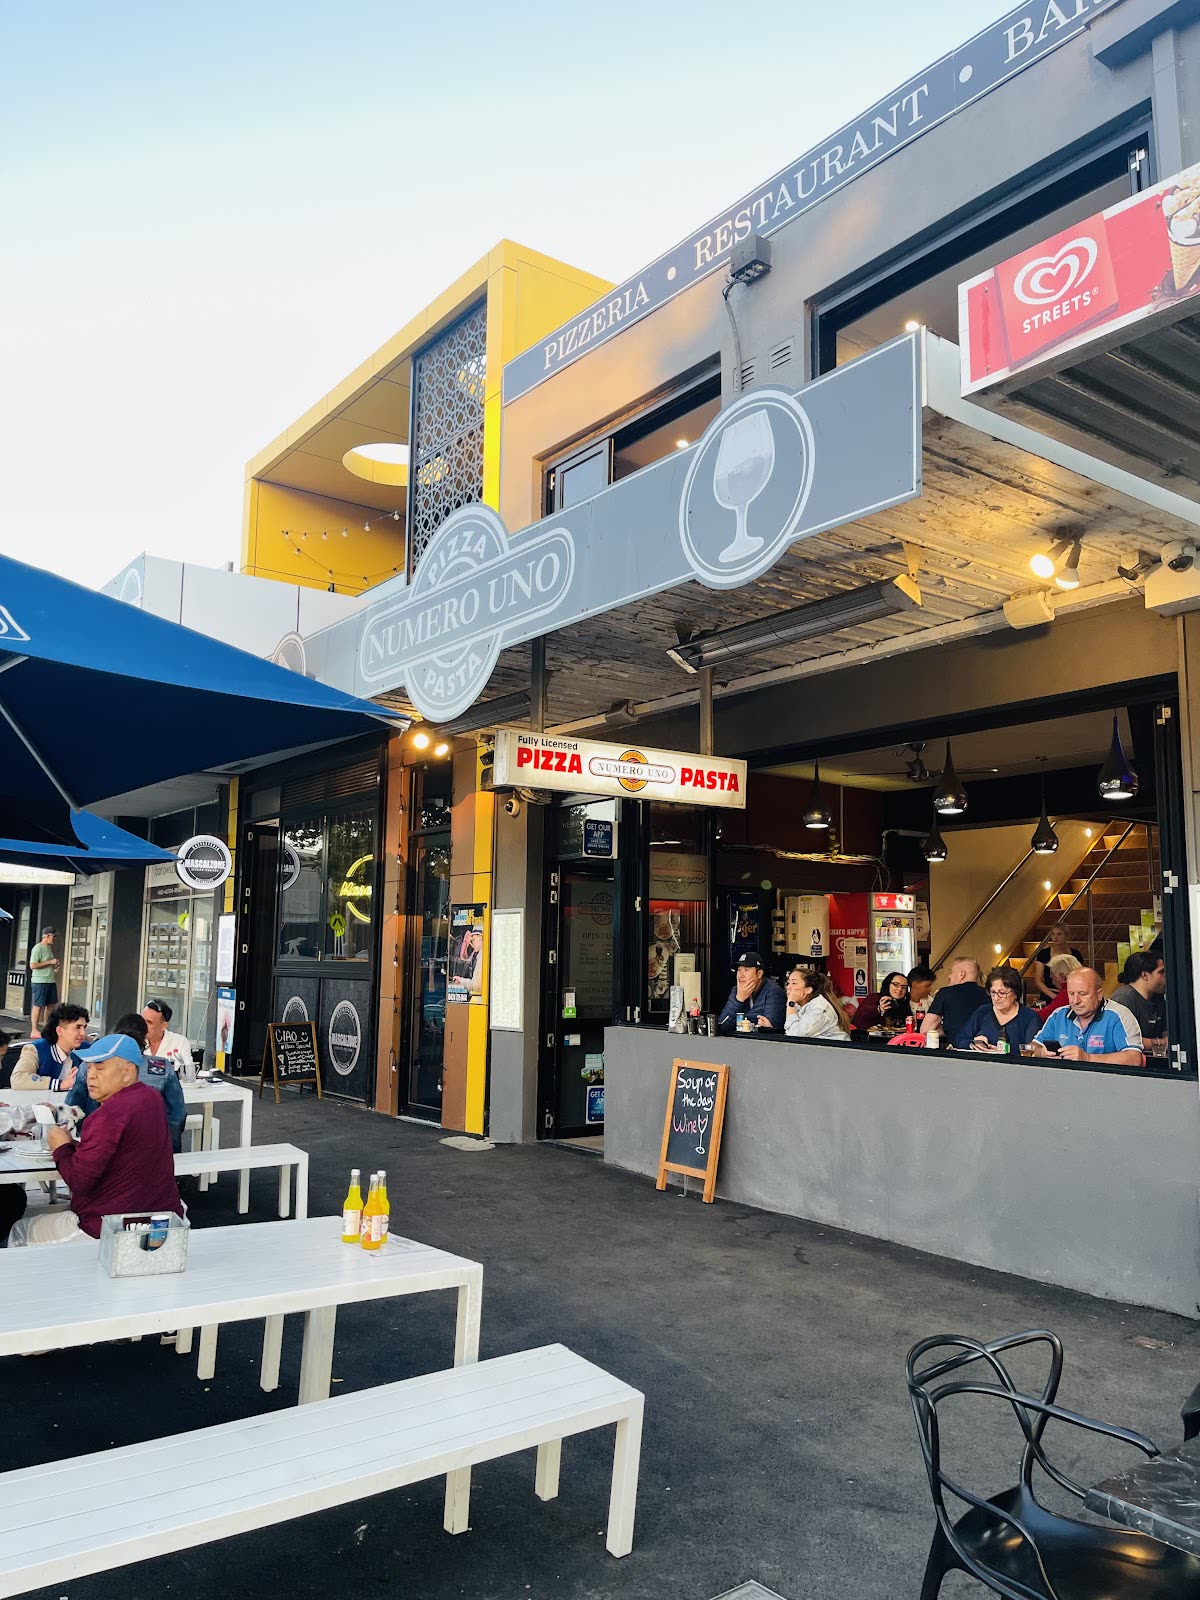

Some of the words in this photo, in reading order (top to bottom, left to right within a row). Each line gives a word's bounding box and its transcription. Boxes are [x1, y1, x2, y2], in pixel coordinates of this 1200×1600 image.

[543, 281, 650, 370] PIZZERIA
[693, 83, 929, 271] RESTAURANT
[1022, 291, 1092, 334] STREETS
[427, 530, 487, 585] PIZZA
[367, 588, 480, 665] NUMERO
[488, 552, 560, 614] UNO
[424, 652, 482, 698] PASTA
[517, 735, 539, 747] Fully
[541, 738, 578, 751] Licensed
[516, 746, 583, 774] PIZZA
[597, 762, 644, 776] NUMERO
[648, 768, 669, 779] UNO
[680, 767, 739, 792] PASTA
[586, 822, 598, 831] GET
[598, 823, 611, 832] OUR
[593, 830, 605, 838] APP
[185, 859, 227, 870] MASCALZONE
[275, 1029, 298, 1043] CIAO
[677, 1069, 703, 1094] Soup
[705, 1073, 717, 1092] of
[682, 1092, 697, 1107] the
[673, 1112, 697, 1134] Wine
